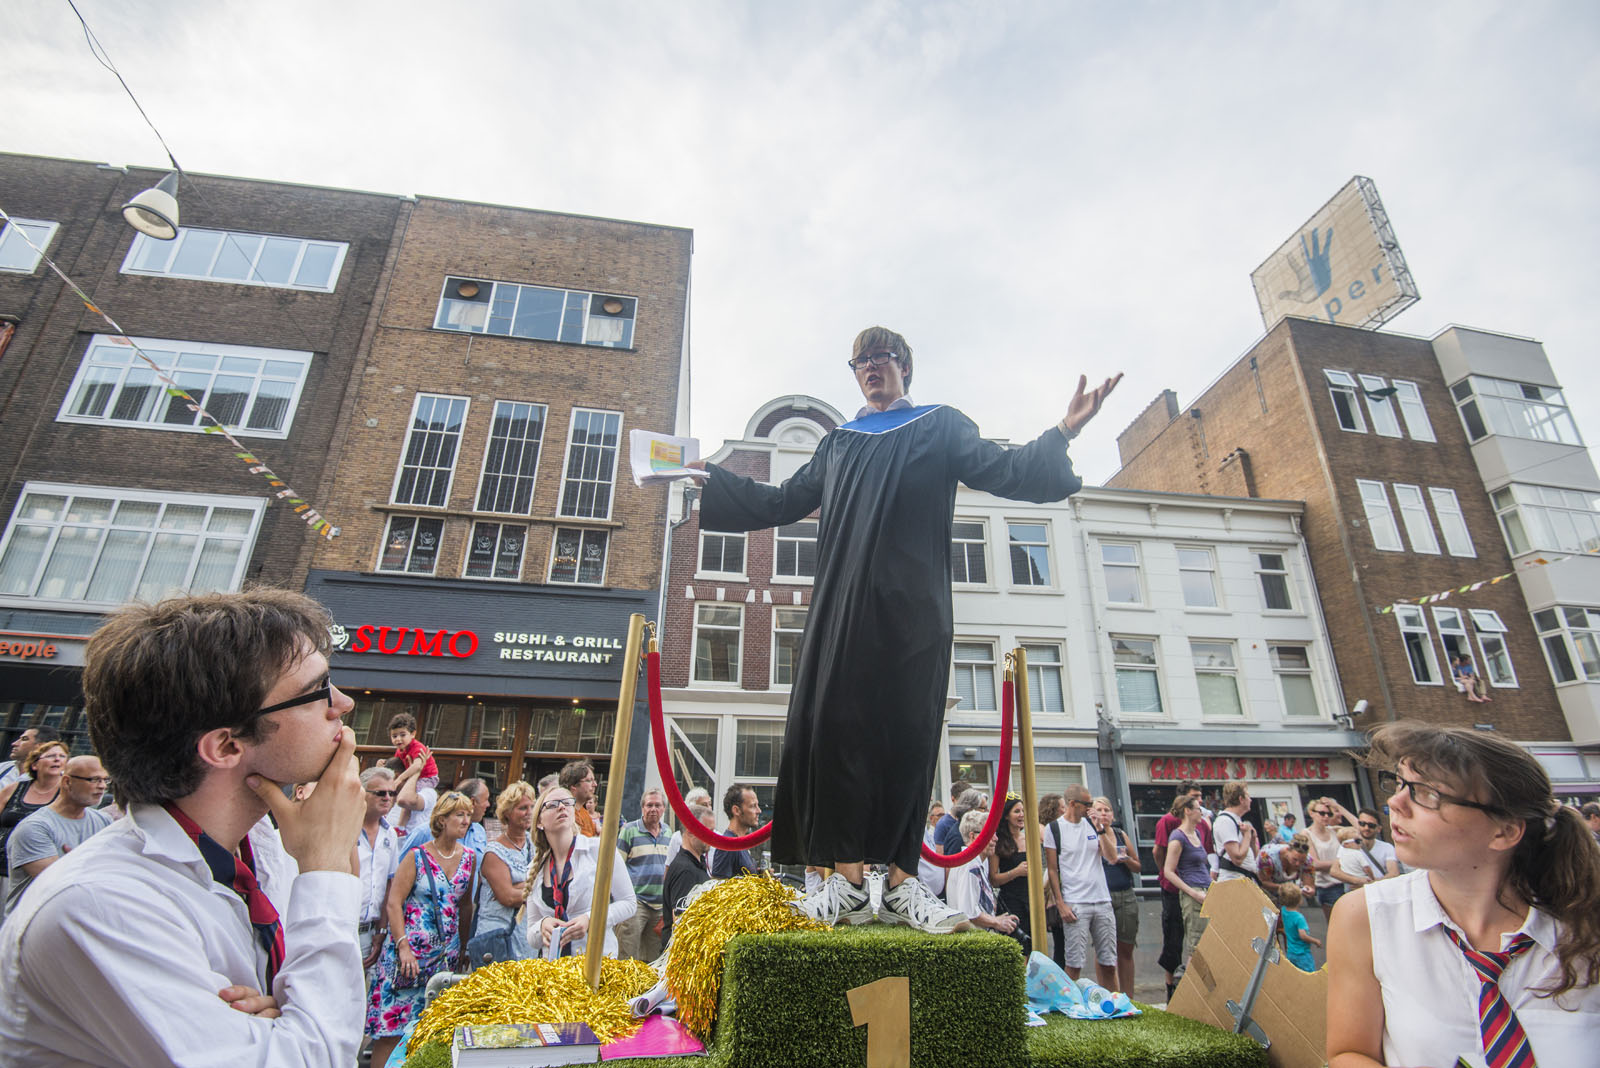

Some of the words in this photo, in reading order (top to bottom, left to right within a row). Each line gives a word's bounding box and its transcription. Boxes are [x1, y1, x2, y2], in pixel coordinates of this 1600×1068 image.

[352, 625, 479, 658] SUMO
[493, 632, 547, 645] SUSHI
[554, 635, 566, 646] &
[573, 636, 622, 649] GRILL
[500, 648, 612, 664] RESTAURANT
[1151, 757, 1247, 780] CAESAR'S
[1255, 757, 1329, 779] PALACE
[846, 976, 910, 1068] 1
